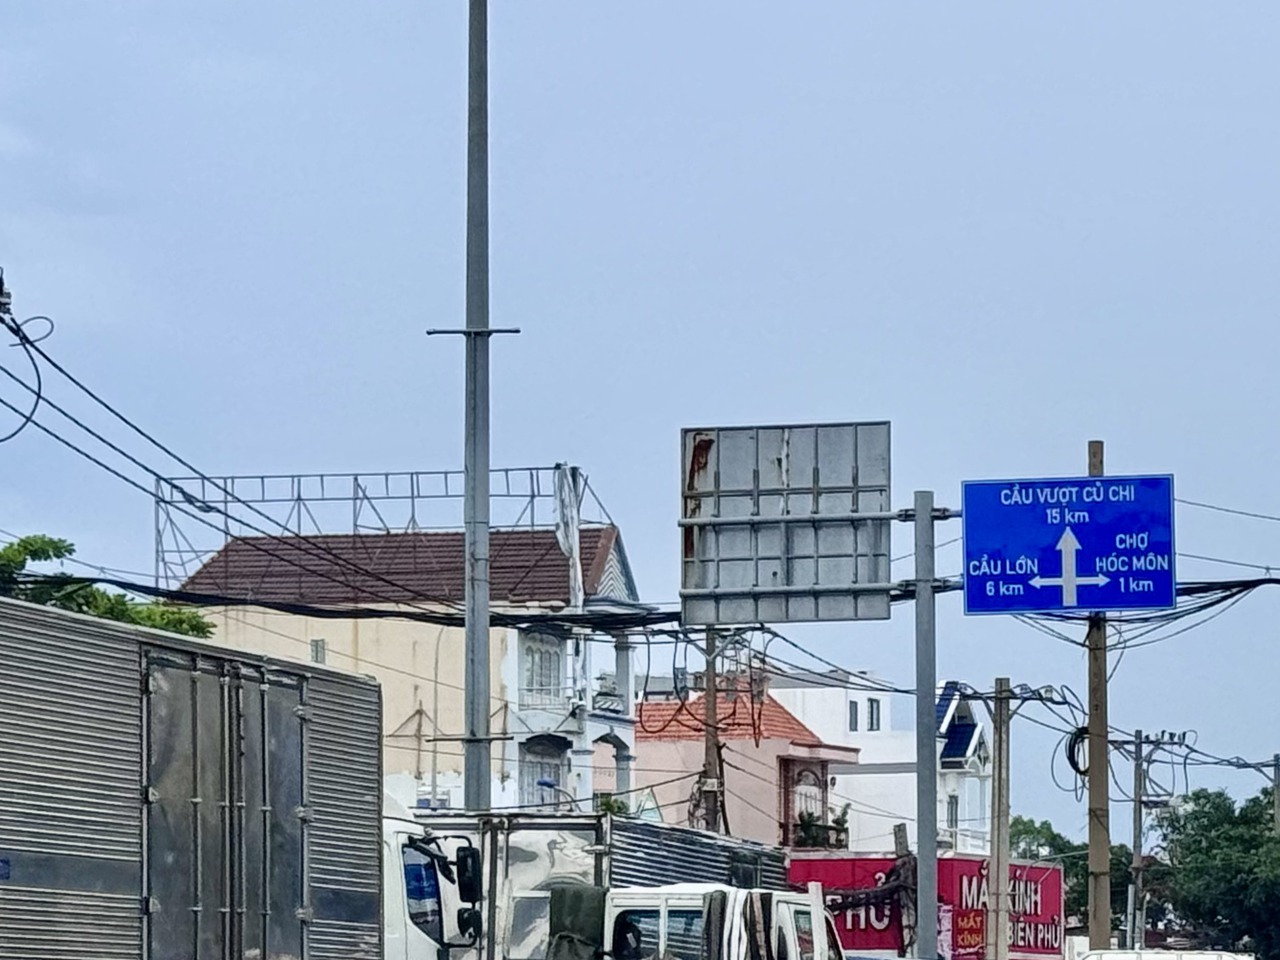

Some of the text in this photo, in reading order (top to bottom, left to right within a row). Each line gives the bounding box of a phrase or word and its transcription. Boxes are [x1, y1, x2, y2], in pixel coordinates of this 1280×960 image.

[1000, 481, 1135, 506] CẦU VƯỢT CỦ CHI
[1046, 508, 1089, 524] 15 km
[1115, 531, 1149, 549] CHỢ
[969, 554, 1039, 576] CẦU LỚN
[1095, 552, 1169, 573] HÓC MÔN
[985, 581, 1024, 596] 6 km
[1119, 577, 1154, 592] 1 km
[1037, 915, 1061, 948] PHỦ
